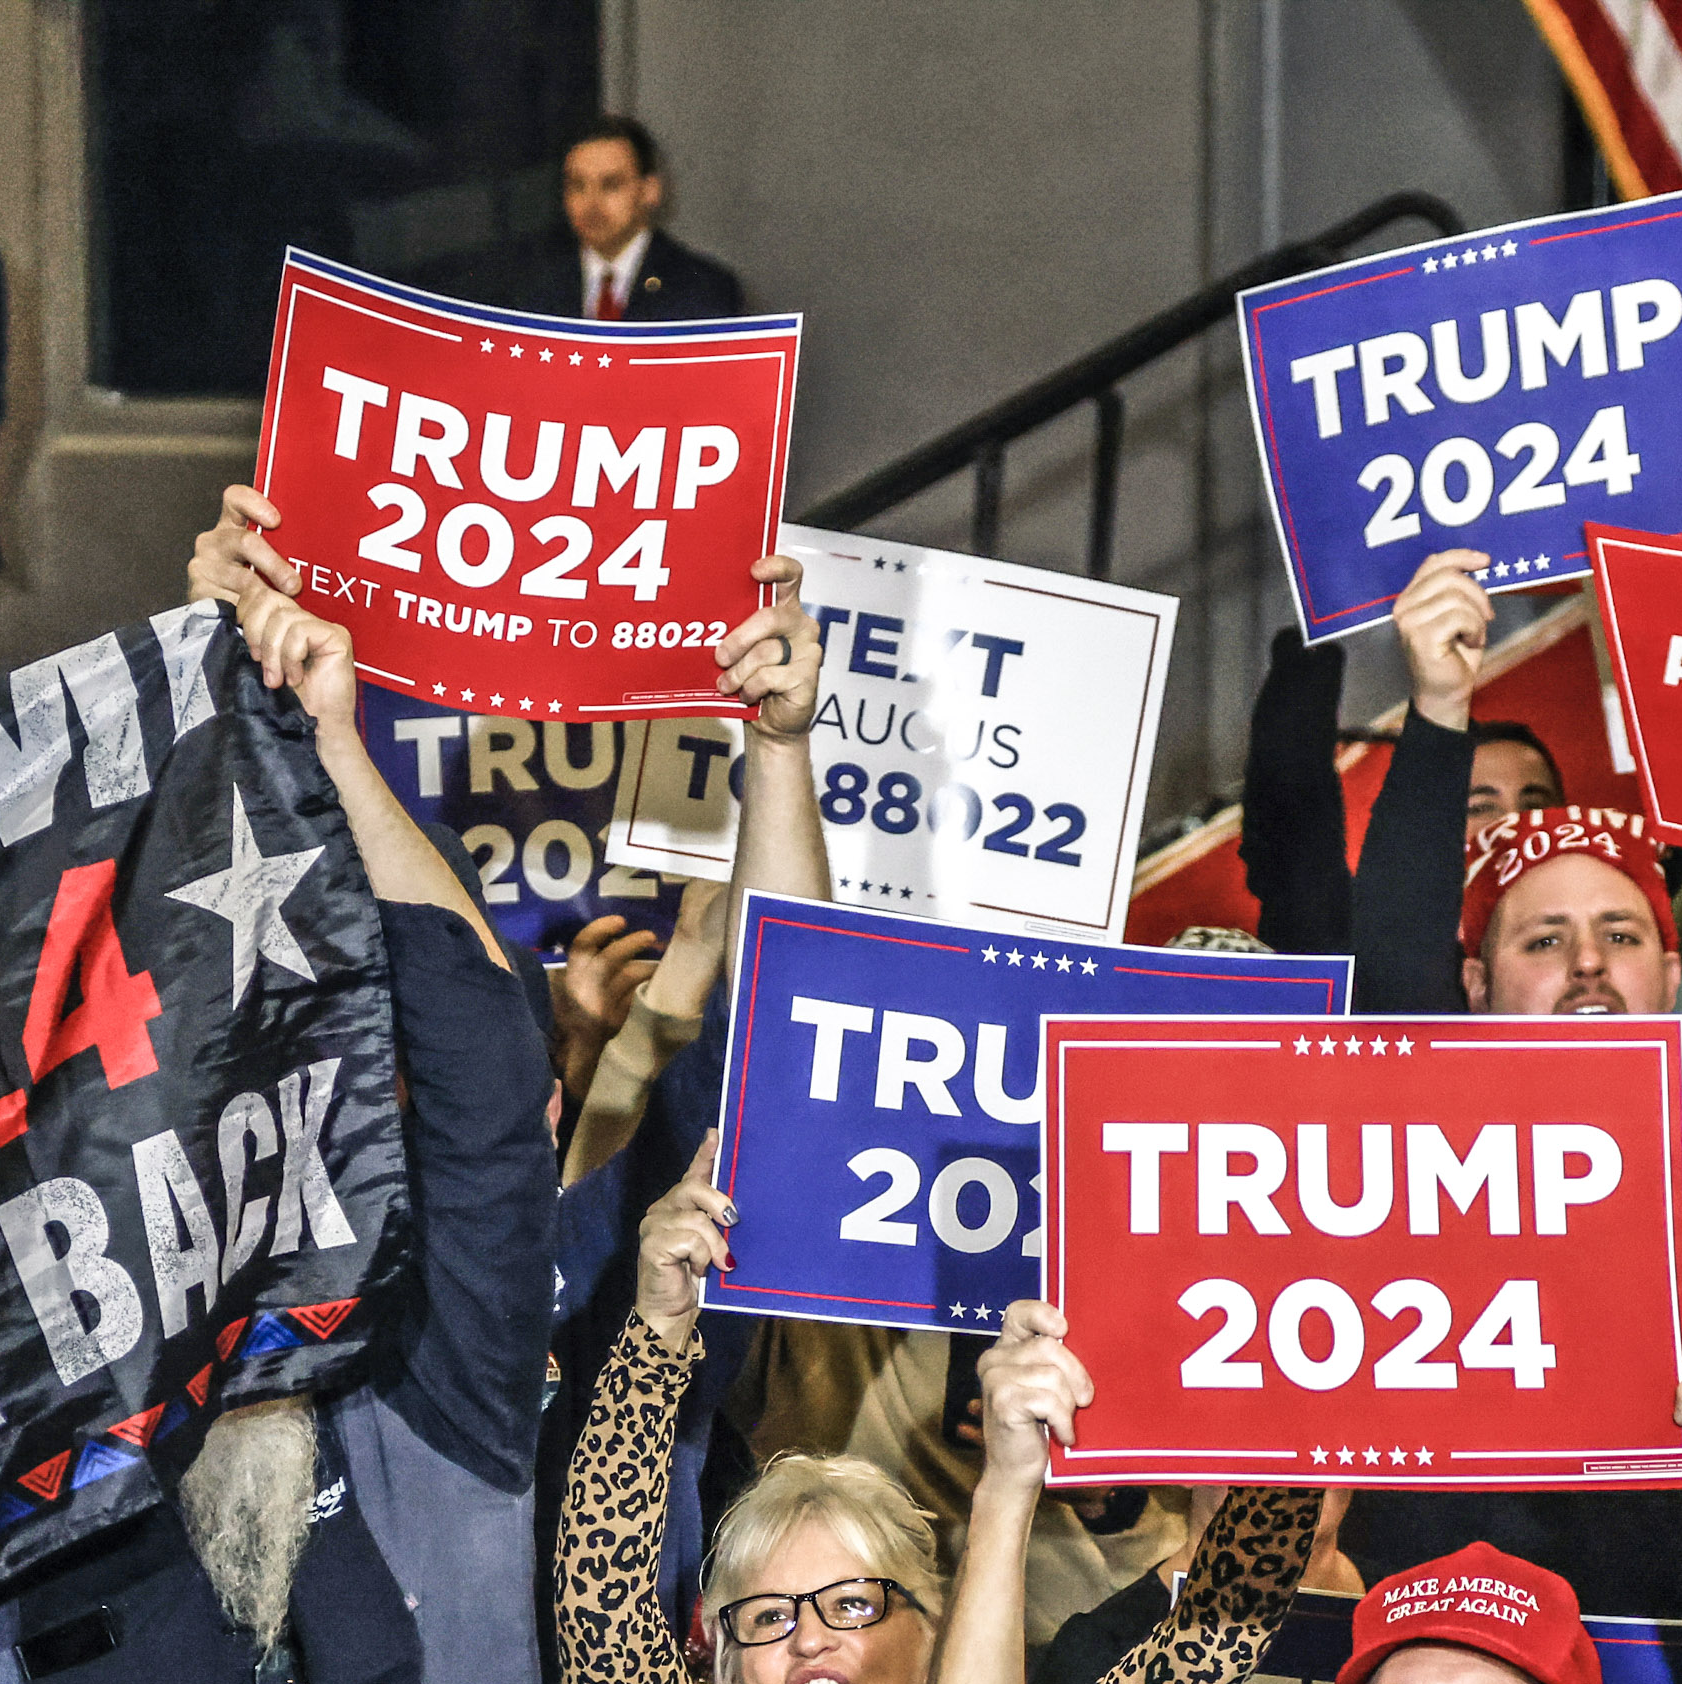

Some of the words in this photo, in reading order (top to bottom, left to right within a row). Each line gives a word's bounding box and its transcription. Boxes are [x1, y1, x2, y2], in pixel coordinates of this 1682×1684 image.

[321, 366, 740, 511] TRUMP
[1357, 405, 1642, 549] 2024
[358, 483, 671, 602] 2024
[287, 558, 381, 610] TEXT
[394, 590, 533, 644] TRUMP
[547, 619, 598, 648] TO
[611, 621, 728, 649] 88022
[801, 602, 1025, 698] TET
[394, 716, 616, 798] TRU
[809, 693, 1023, 769] AUCUS
[677, 735, 745, 800] T
[819, 762, 1087, 867] 88022
[461, 820, 687, 904] 202
[1495, 823, 1623, 886] 2024
[790, 996, 1044, 1125] TRU
[839, 1146, 1044, 1259] 20
[1101, 1122, 1624, 1239] TRUMP
[1176, 1278, 1558, 1392] 2024
[1382, 1578, 1440, 1607] MAKE
[1442, 1577, 1540, 1612] AMERICA
[1386, 1598, 1455, 1623] GREAT
[1455, 1597, 1529, 1626] AGAIN
